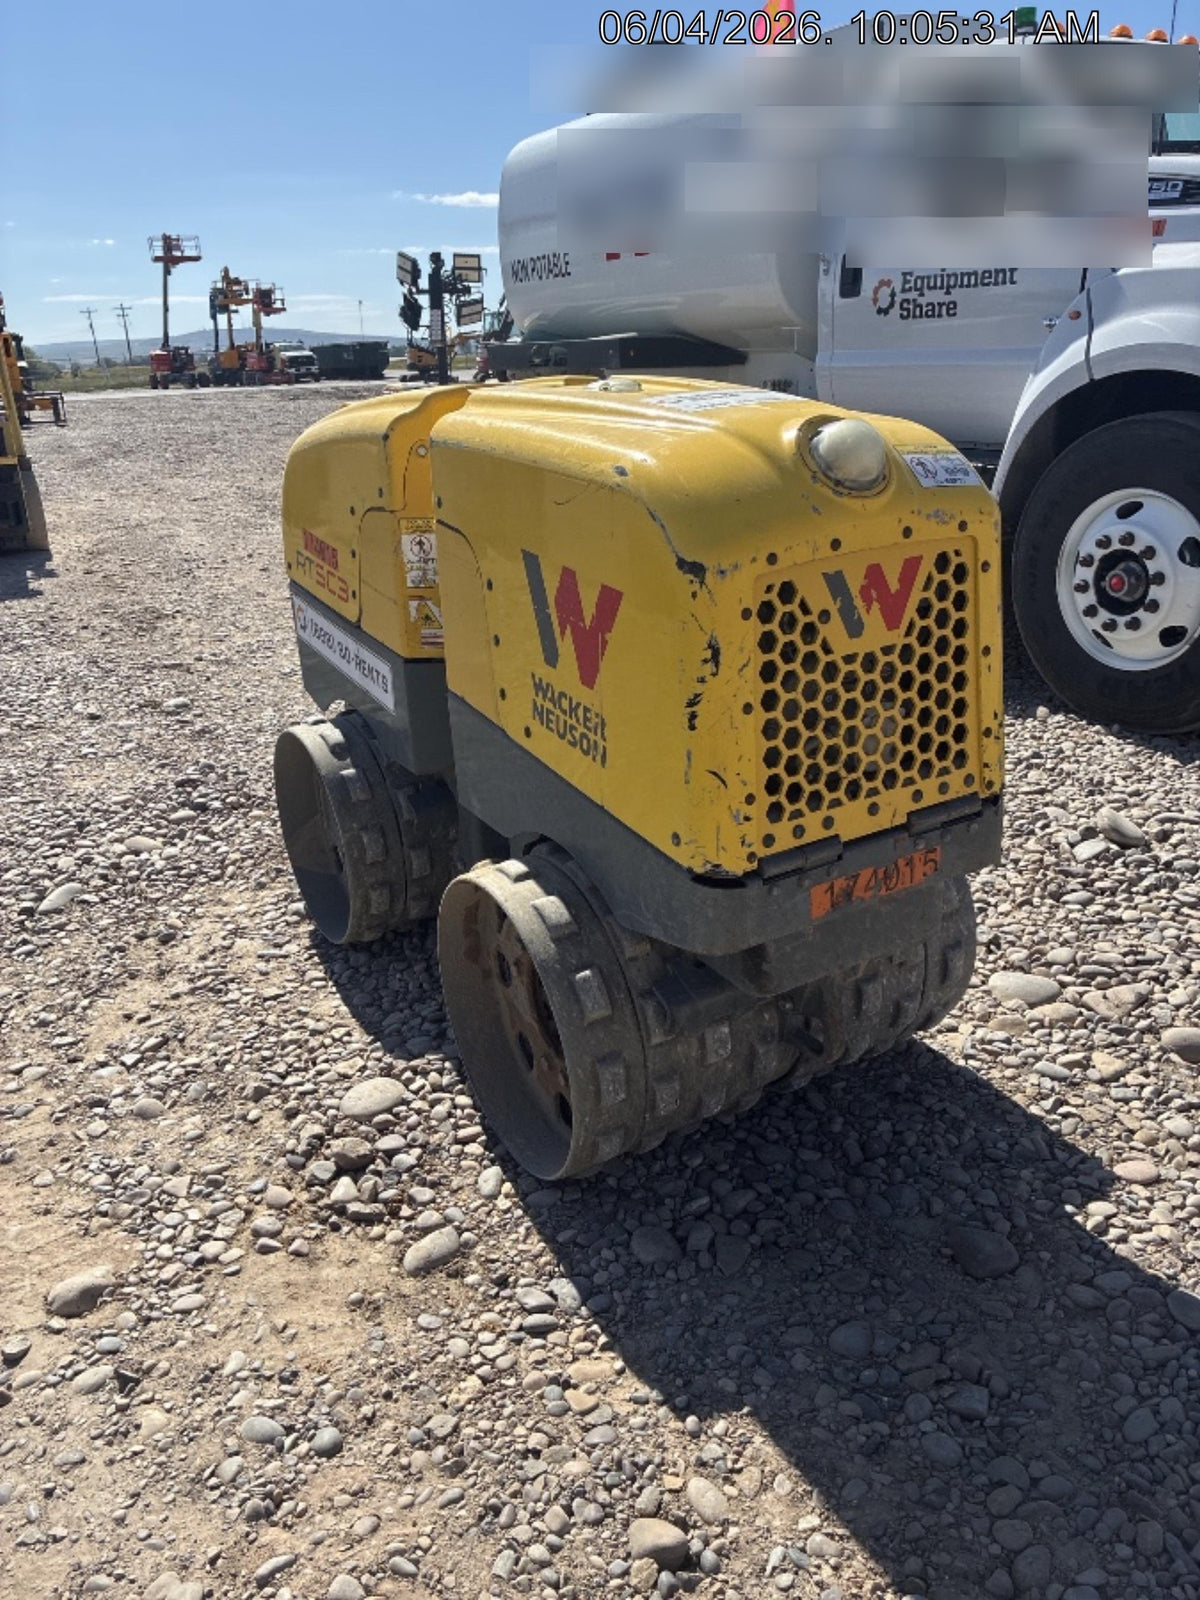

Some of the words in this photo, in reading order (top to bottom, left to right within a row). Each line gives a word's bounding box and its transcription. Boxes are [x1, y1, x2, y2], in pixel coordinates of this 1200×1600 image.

[530, 252, 571, 281] POTABLE
[900, 267, 1018, 297] Equipment
[899, 298, 957, 320] Share
[531, 671, 606, 742] WACKER
[532, 698, 607, 769] NEUSON
